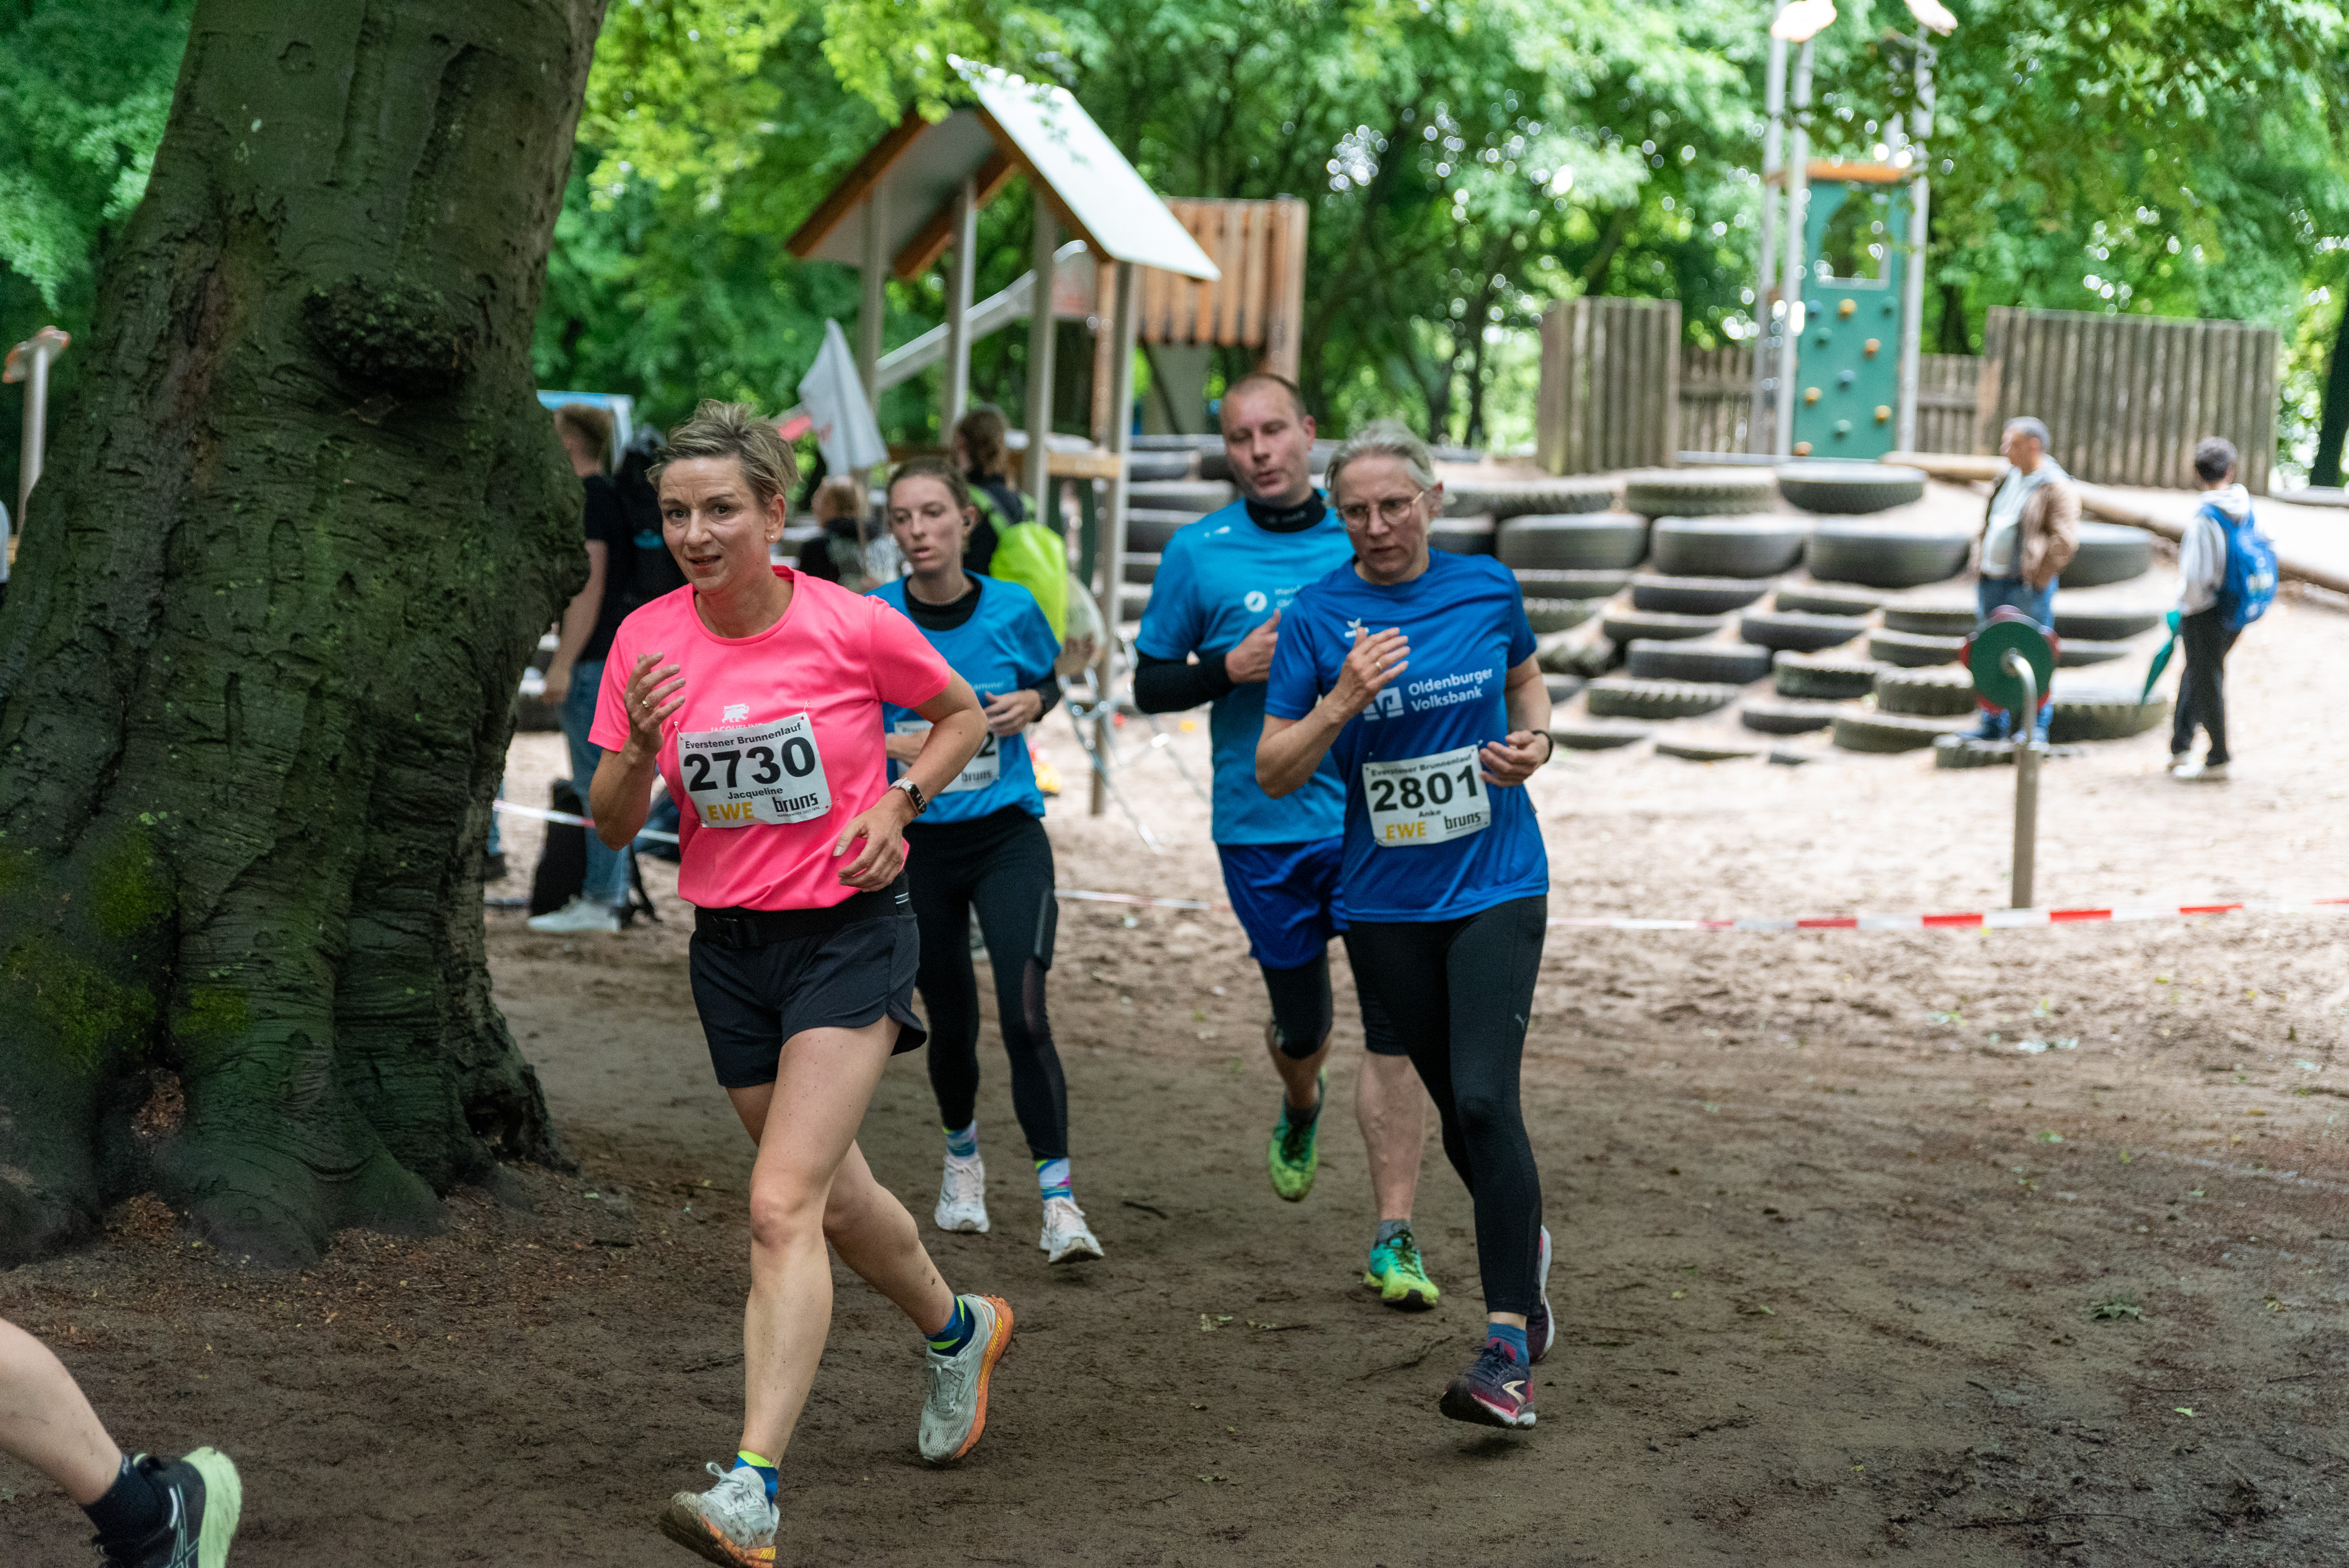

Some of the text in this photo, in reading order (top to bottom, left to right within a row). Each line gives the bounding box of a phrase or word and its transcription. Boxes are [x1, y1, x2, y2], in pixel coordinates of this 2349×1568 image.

[1408, 669, 1493, 696] Oldenburger
[1411, 686, 1482, 711] Volksbank
[685, 722, 802, 749] Everstener Brunnenlauf
[683, 737, 815, 792] 2730
[727, 787, 784, 800] Jacqueline
[1370, 765, 1478, 812] 2801
[707, 802, 754, 821] EWE
[772, 792, 818, 813] bruns
[1418, 810, 1441, 818] Anke
[1444, 812, 1481, 829] bruns
[1385, 821, 1427, 840] EWE
